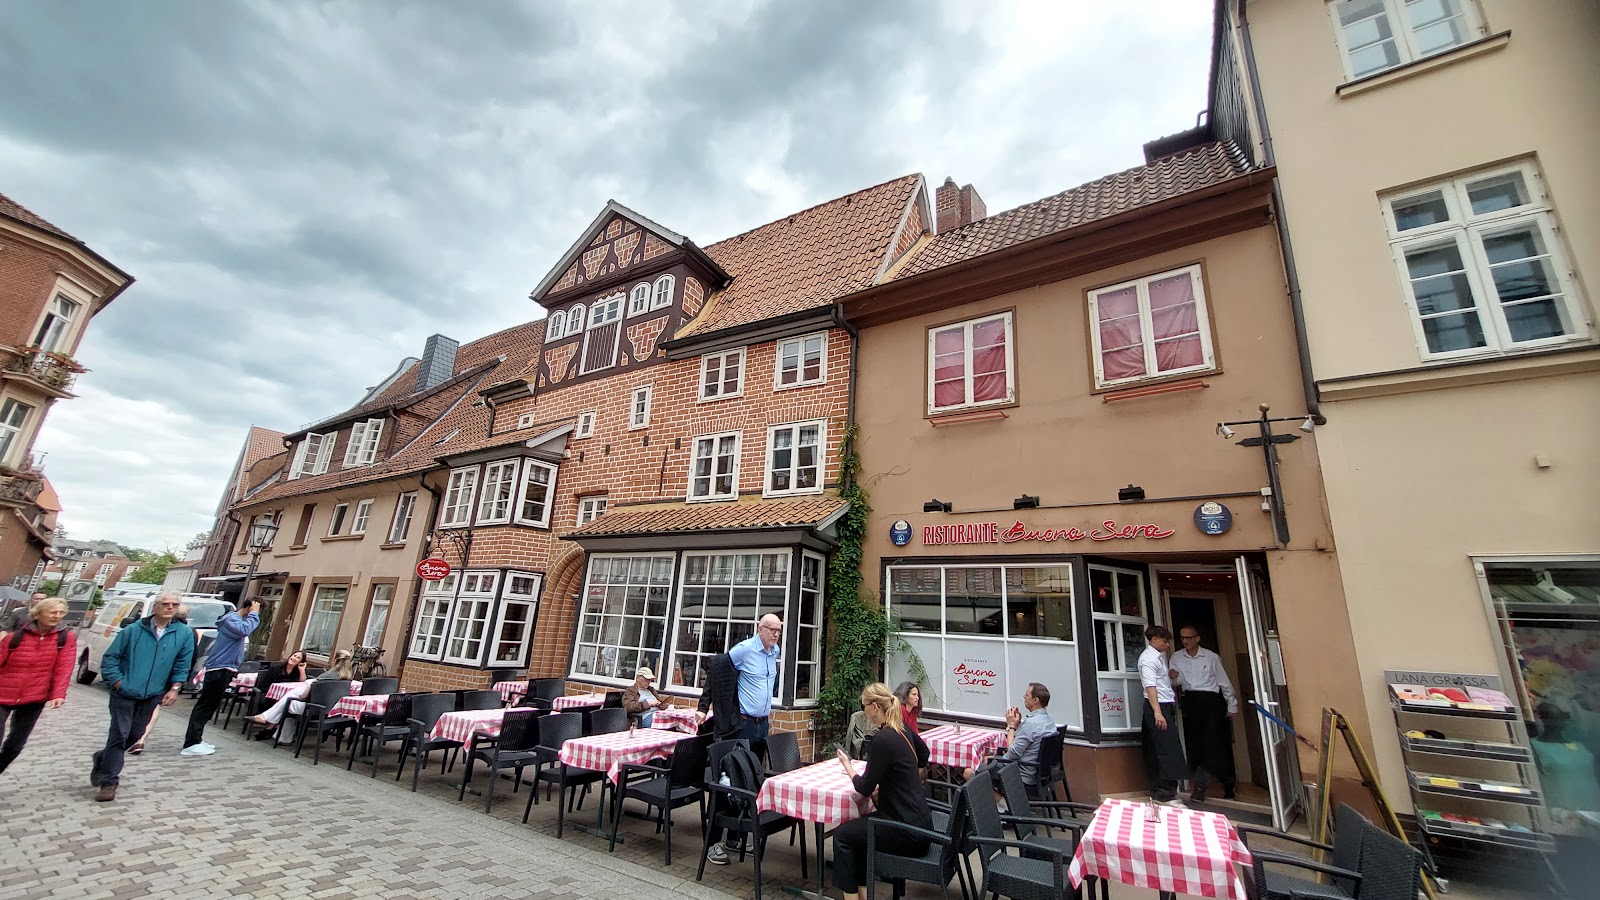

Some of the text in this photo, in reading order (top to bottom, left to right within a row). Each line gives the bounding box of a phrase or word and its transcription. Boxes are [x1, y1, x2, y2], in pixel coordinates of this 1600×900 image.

[922, 519, 1175, 545] RISTORANTE Buona Sera
[420, 562, 447, 571] Buona
[953, 663, 997, 677] Buona
[957, 674, 995, 687] Sera
[1394, 673, 1429, 685] LANA
